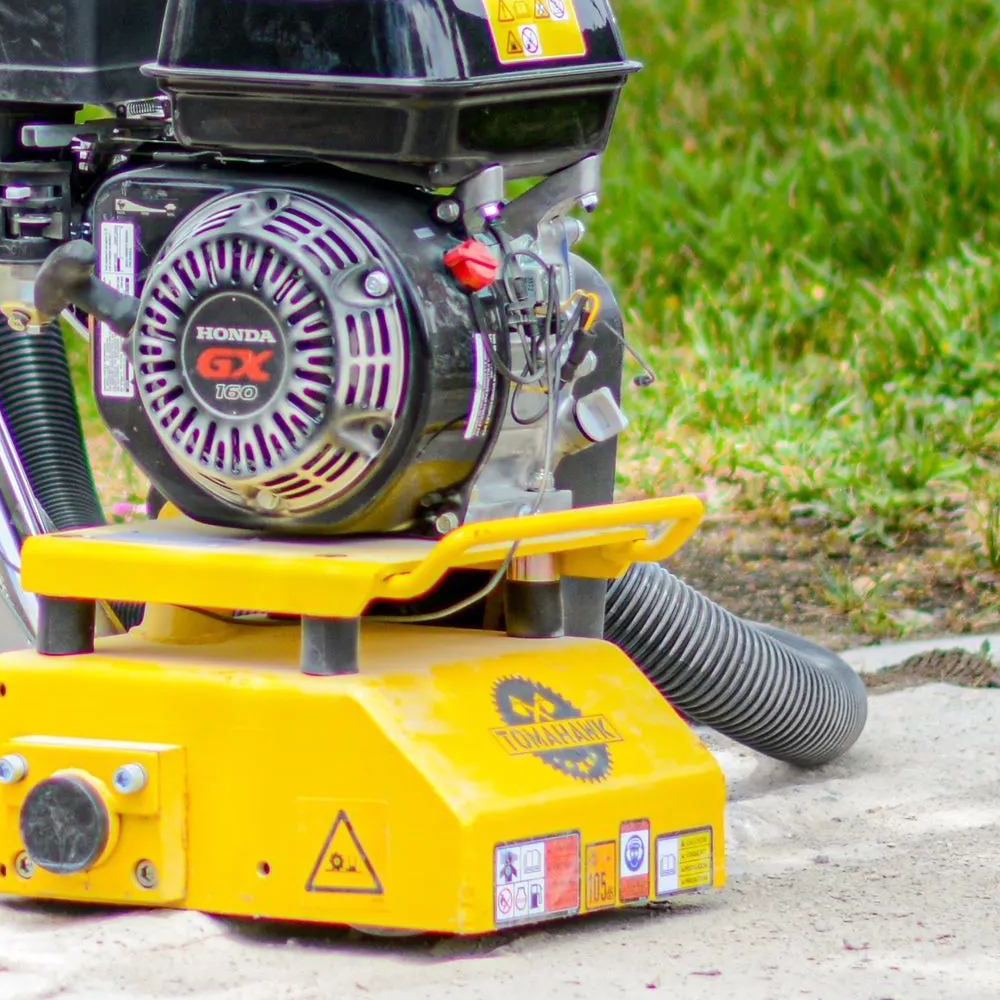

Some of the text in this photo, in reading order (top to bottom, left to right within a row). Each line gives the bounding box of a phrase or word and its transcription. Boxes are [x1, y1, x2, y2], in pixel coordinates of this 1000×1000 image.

[196, 326, 277, 343] HONDA
[196, 347, 274, 383] GX
[216, 383, 258, 401] 160
[495, 718, 616, 751] TOMAHAWK
[587, 871, 606, 904] 105
